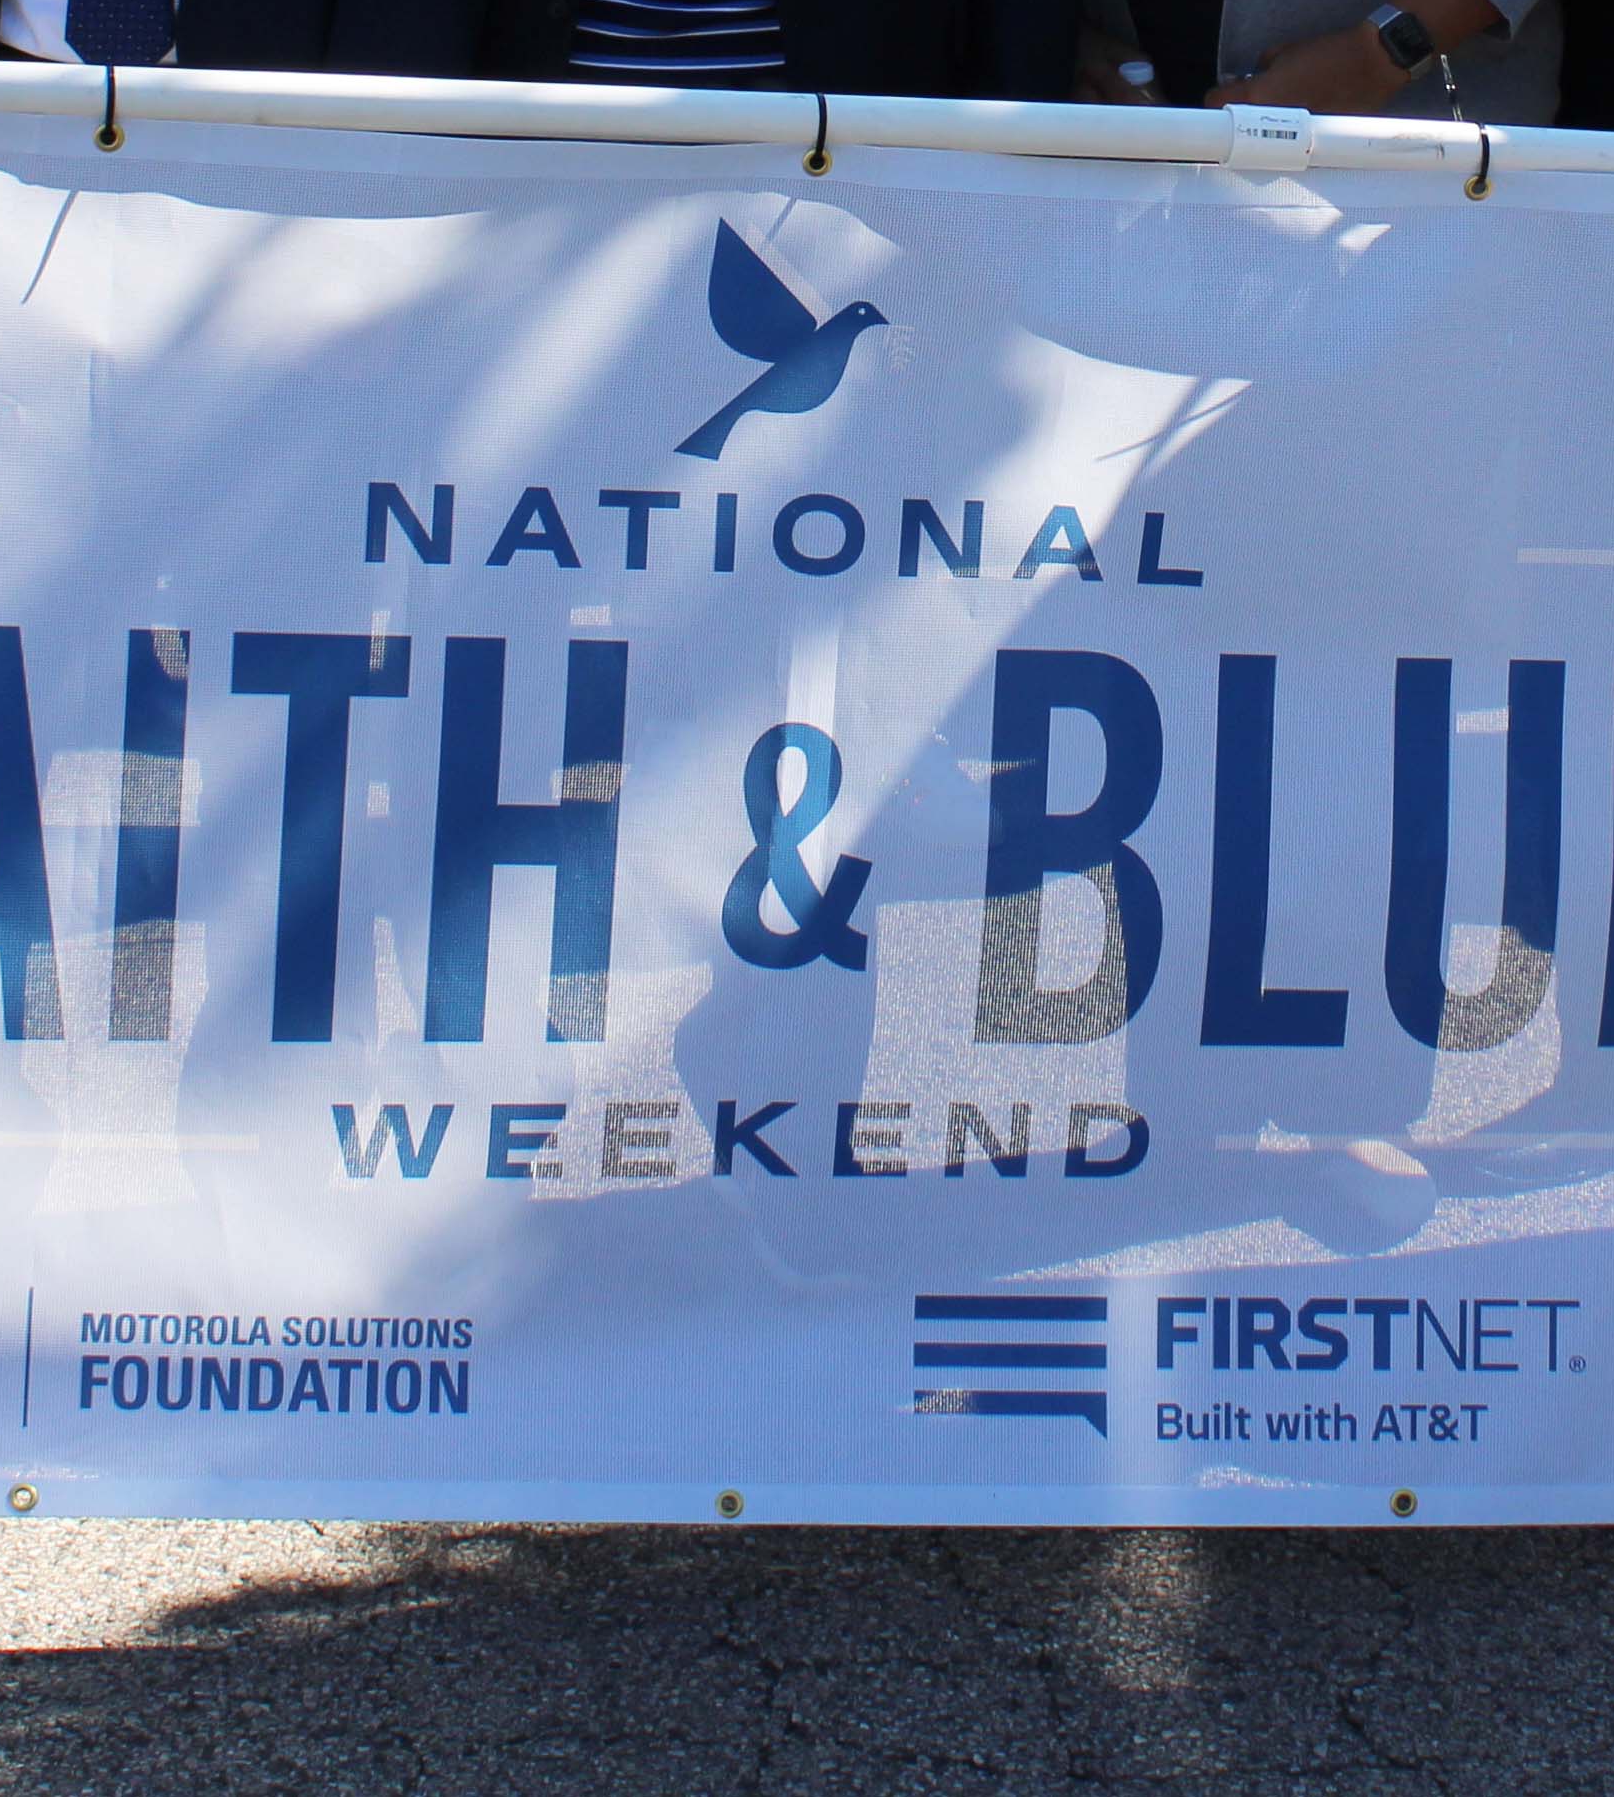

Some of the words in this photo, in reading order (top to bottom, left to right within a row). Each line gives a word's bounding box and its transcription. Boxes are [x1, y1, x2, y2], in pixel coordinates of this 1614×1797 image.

[364, 482, 1204, 587] NATIONAL
[721, 722, 873, 972] &
[331, 1099, 1151, 1180] WEEKEND
[80, 1314, 269, 1348] MOTOROLA
[282, 1317, 474, 1350] SOLUTIONS
[80, 1357, 470, 1416] FOUNDATION
[1157, 1402, 1252, 1443] Built
[1265, 1403, 1358, 1443] with
[1371, 1404, 1489, 1443] AT&T
